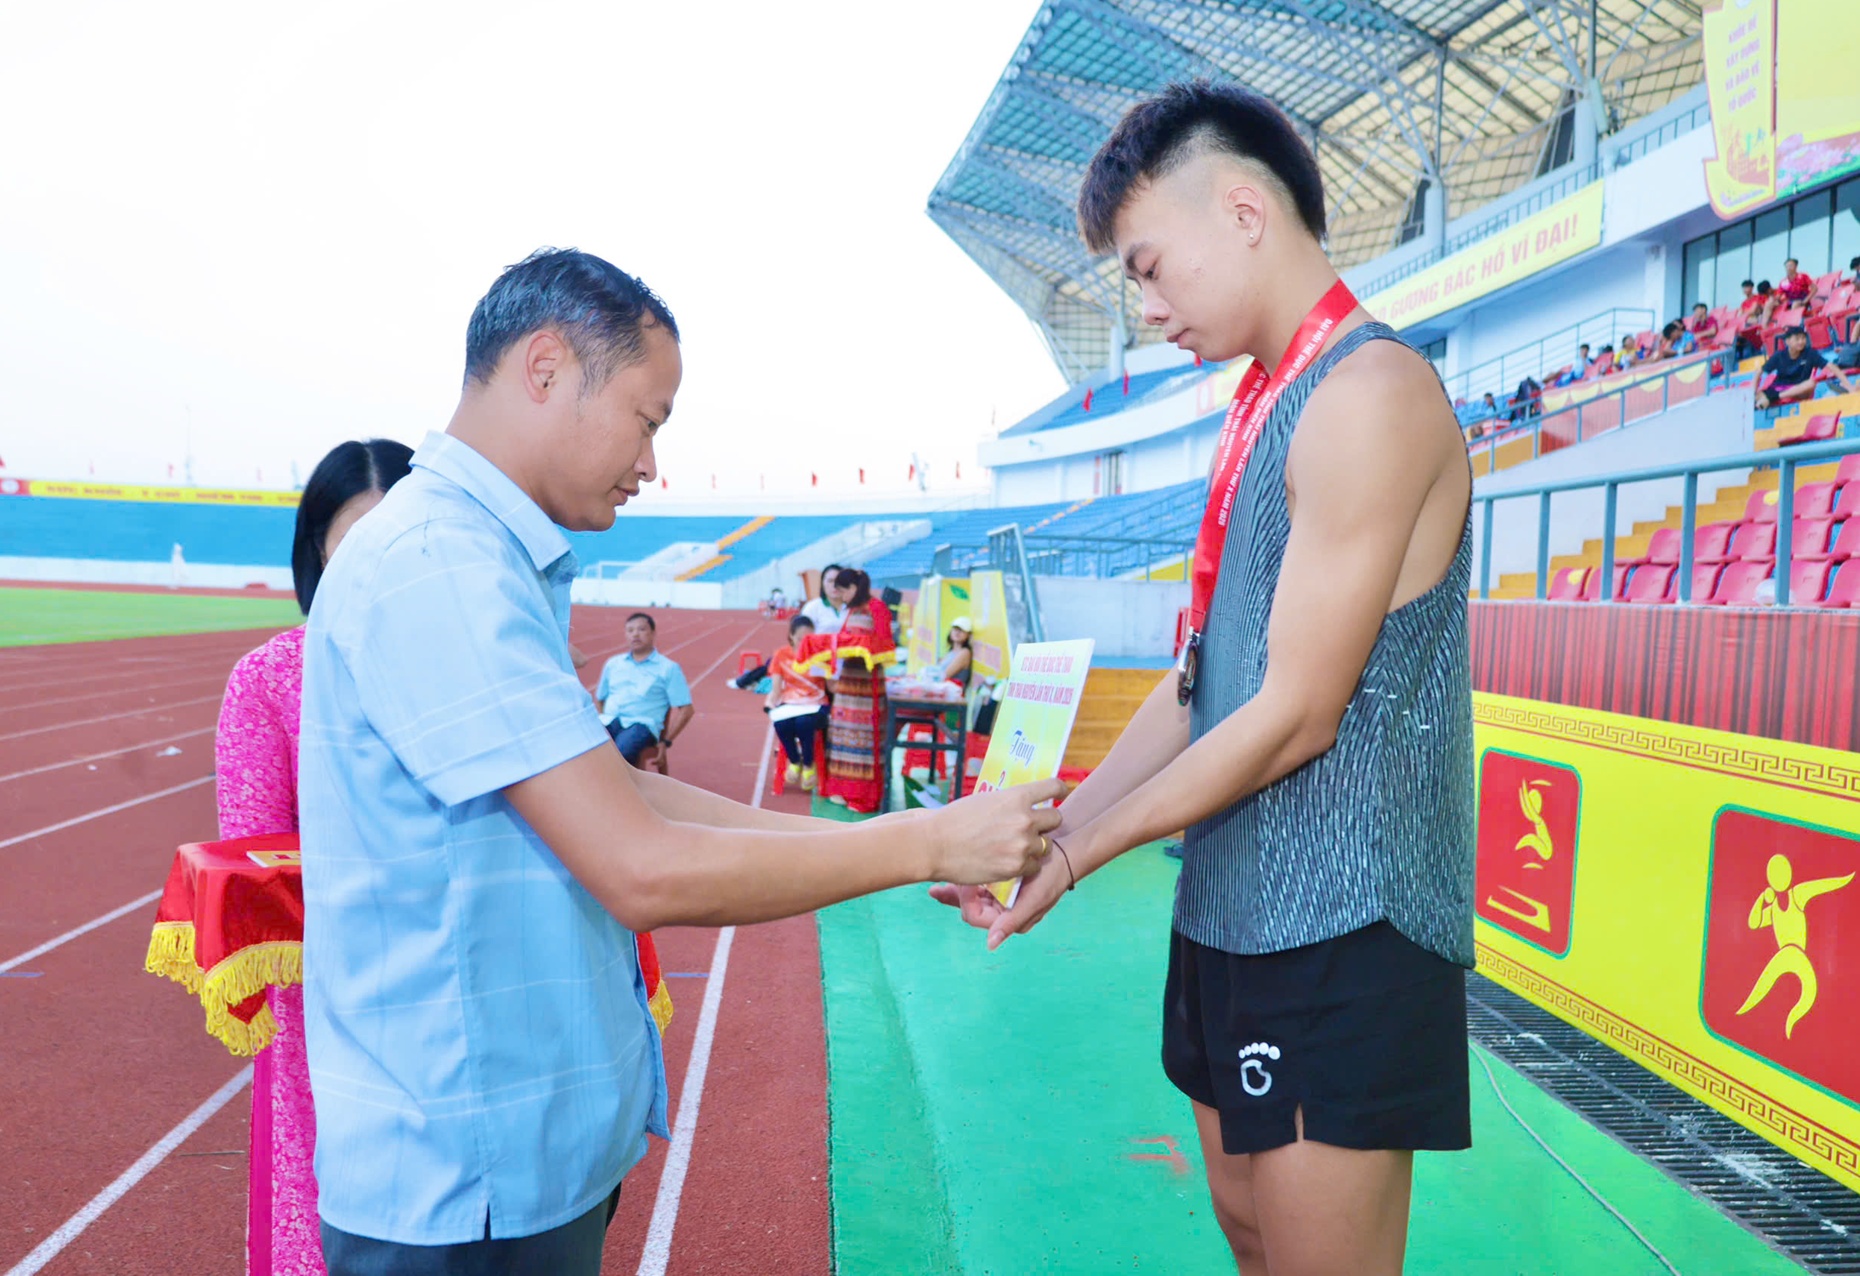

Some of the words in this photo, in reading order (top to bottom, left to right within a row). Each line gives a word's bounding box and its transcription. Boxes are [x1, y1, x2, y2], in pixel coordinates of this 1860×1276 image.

[1443, 264, 1476, 296] BÁC
[1481, 243, 1505, 280] HỒ
[1535, 213, 1578, 255] ĐẠI!
[1319, 317, 1332, 331] ĐẠI
[1311, 329, 1324, 343] HỘI
[1302, 342, 1316, 356] THỂ
[1291, 353, 1306, 369] DỤC
[1284, 369, 1296, 382] THỂ
[1272, 381, 1286, 398] THAO
[1263, 397, 1273, 414] TỈNH
[1254, 414, 1265, 429] THÁI
[1241, 430, 1258, 457] NGUYÊN
[1235, 457, 1244, 472] LẦN
[1009, 730, 1035, 767] Tặng
